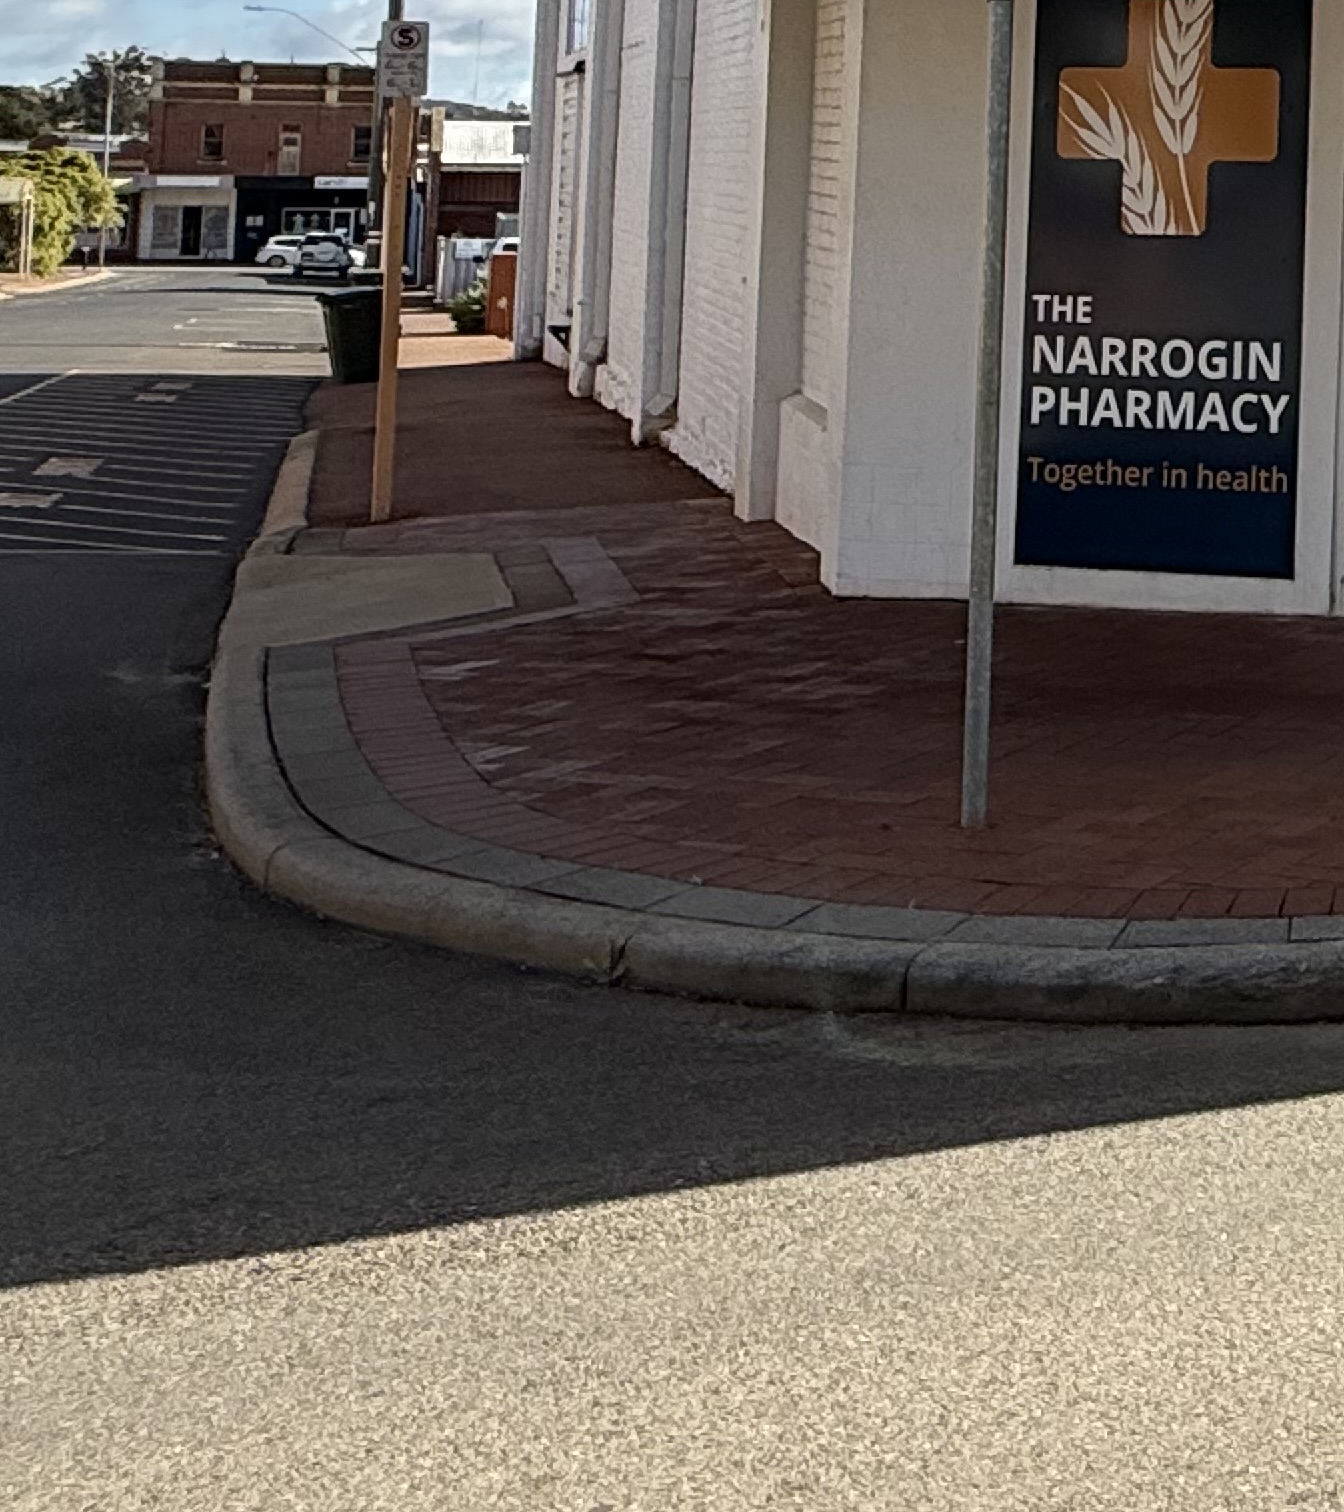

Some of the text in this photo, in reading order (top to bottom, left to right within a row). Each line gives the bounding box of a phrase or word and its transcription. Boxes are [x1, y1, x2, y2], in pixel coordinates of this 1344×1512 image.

[1032, 294, 1093, 323] THE
[1032, 335, 1282, 381] NARROGIN
[1030, 386, 1290, 434] PHARMACY
[1027, 457, 1288, 493] Together in health
